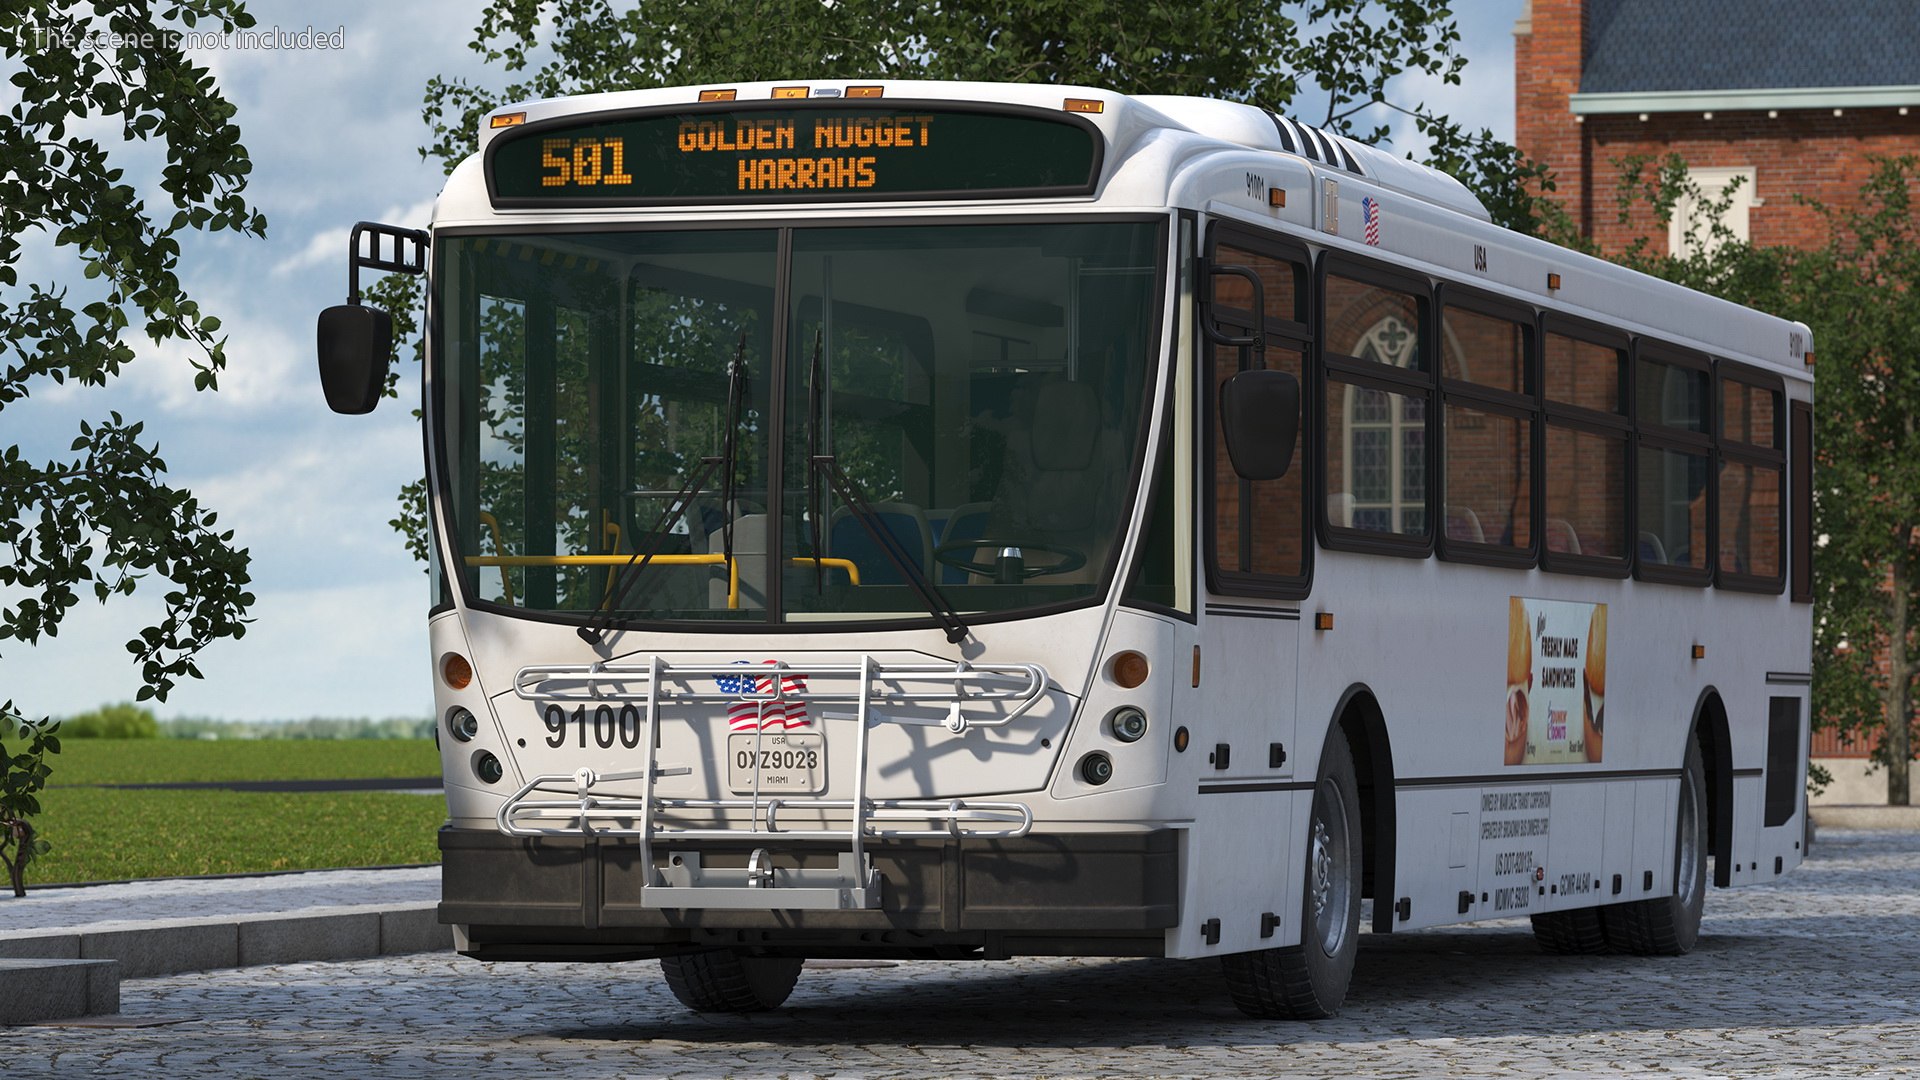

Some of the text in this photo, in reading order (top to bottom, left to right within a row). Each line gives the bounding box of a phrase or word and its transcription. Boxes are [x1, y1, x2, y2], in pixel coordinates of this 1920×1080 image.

[677, 115, 935, 152] GOLDEN NUGGET
[541, 137, 633, 187] 501
[738, 156, 876, 190] HARRAHS
[1246, 171, 1265, 202] 91001
[1474, 244, 1488, 273] USA
[1541, 636, 1579, 660] FRESHLY MADE
[1541, 666, 1576, 689] SANDWICHES
[772, 737, 786, 745] USA
[766, 775, 789, 784] MIAMI
[1495, 853, 1503, 876] US
